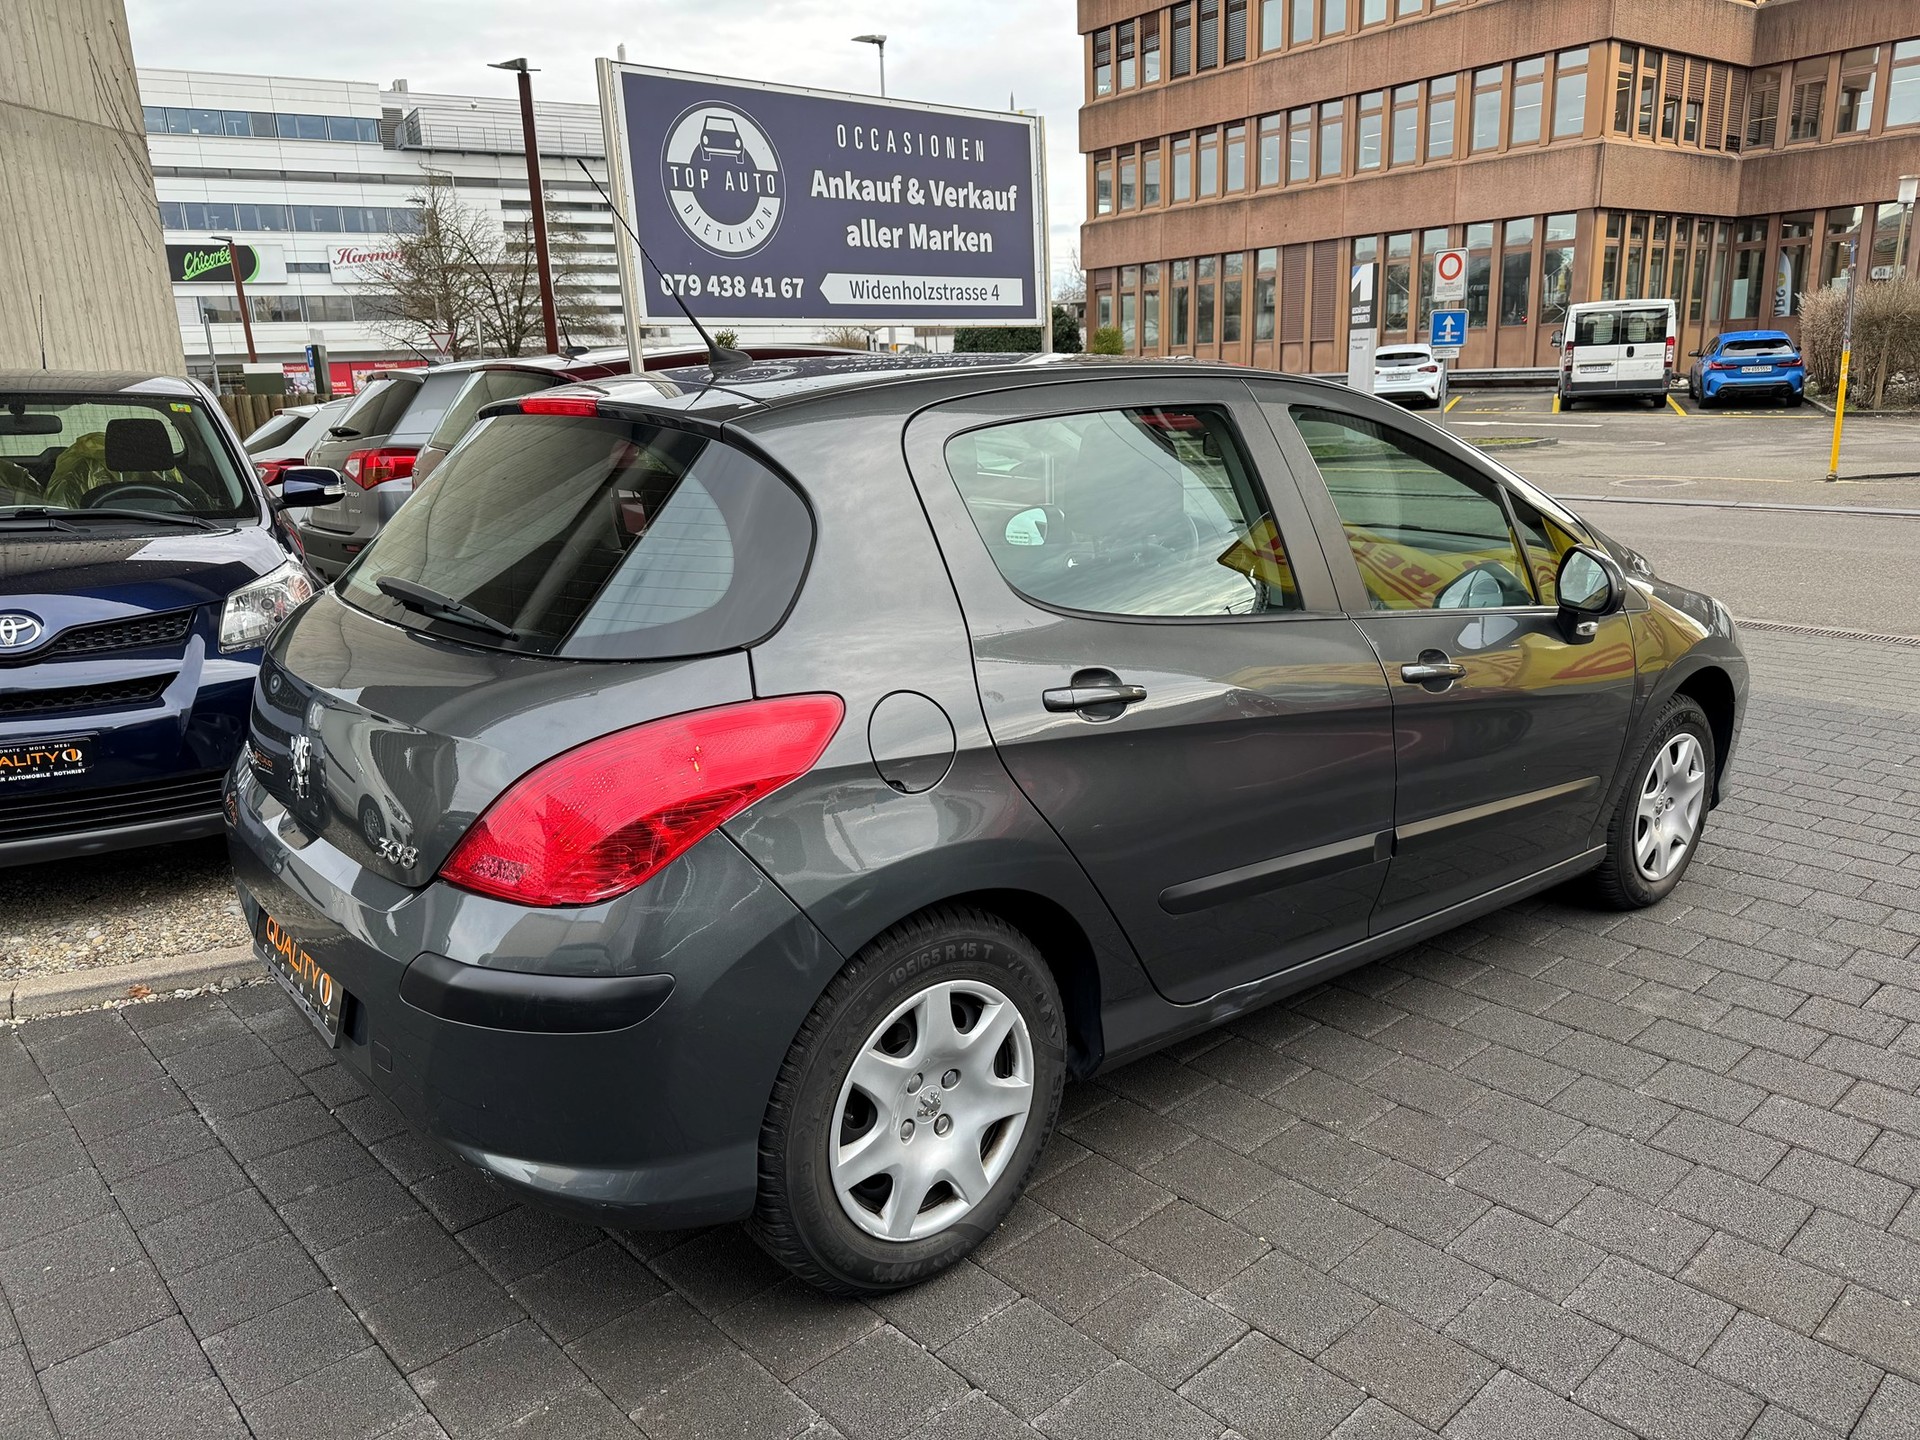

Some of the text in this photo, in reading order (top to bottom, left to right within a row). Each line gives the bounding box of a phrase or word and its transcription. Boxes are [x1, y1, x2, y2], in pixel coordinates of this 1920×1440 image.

[836, 124, 985, 162] OCCASIONEN
[670, 166, 776, 195] TOP AUTO
[810, 169, 1018, 212] Ankauf & Verkauf
[683, 202, 774, 245] DIETLIKON
[846, 218, 994, 253] aller Marken
[660, 273, 804, 299] 079 438 41 67
[849, 279, 1000, 302] Widenholzstrasse 4
[0, 750, 59, 767] ALITY
[8, 772, 51, 782] AUTOMOBILE
[53, 768, 86, 777] ROTHRIST
[376, 837, 418, 870] 308
[266, 915, 321, 989] QUALITY
[888, 942, 994, 987] 195/65 R 15 T
[264, 944, 329, 1025] GARANTIE
